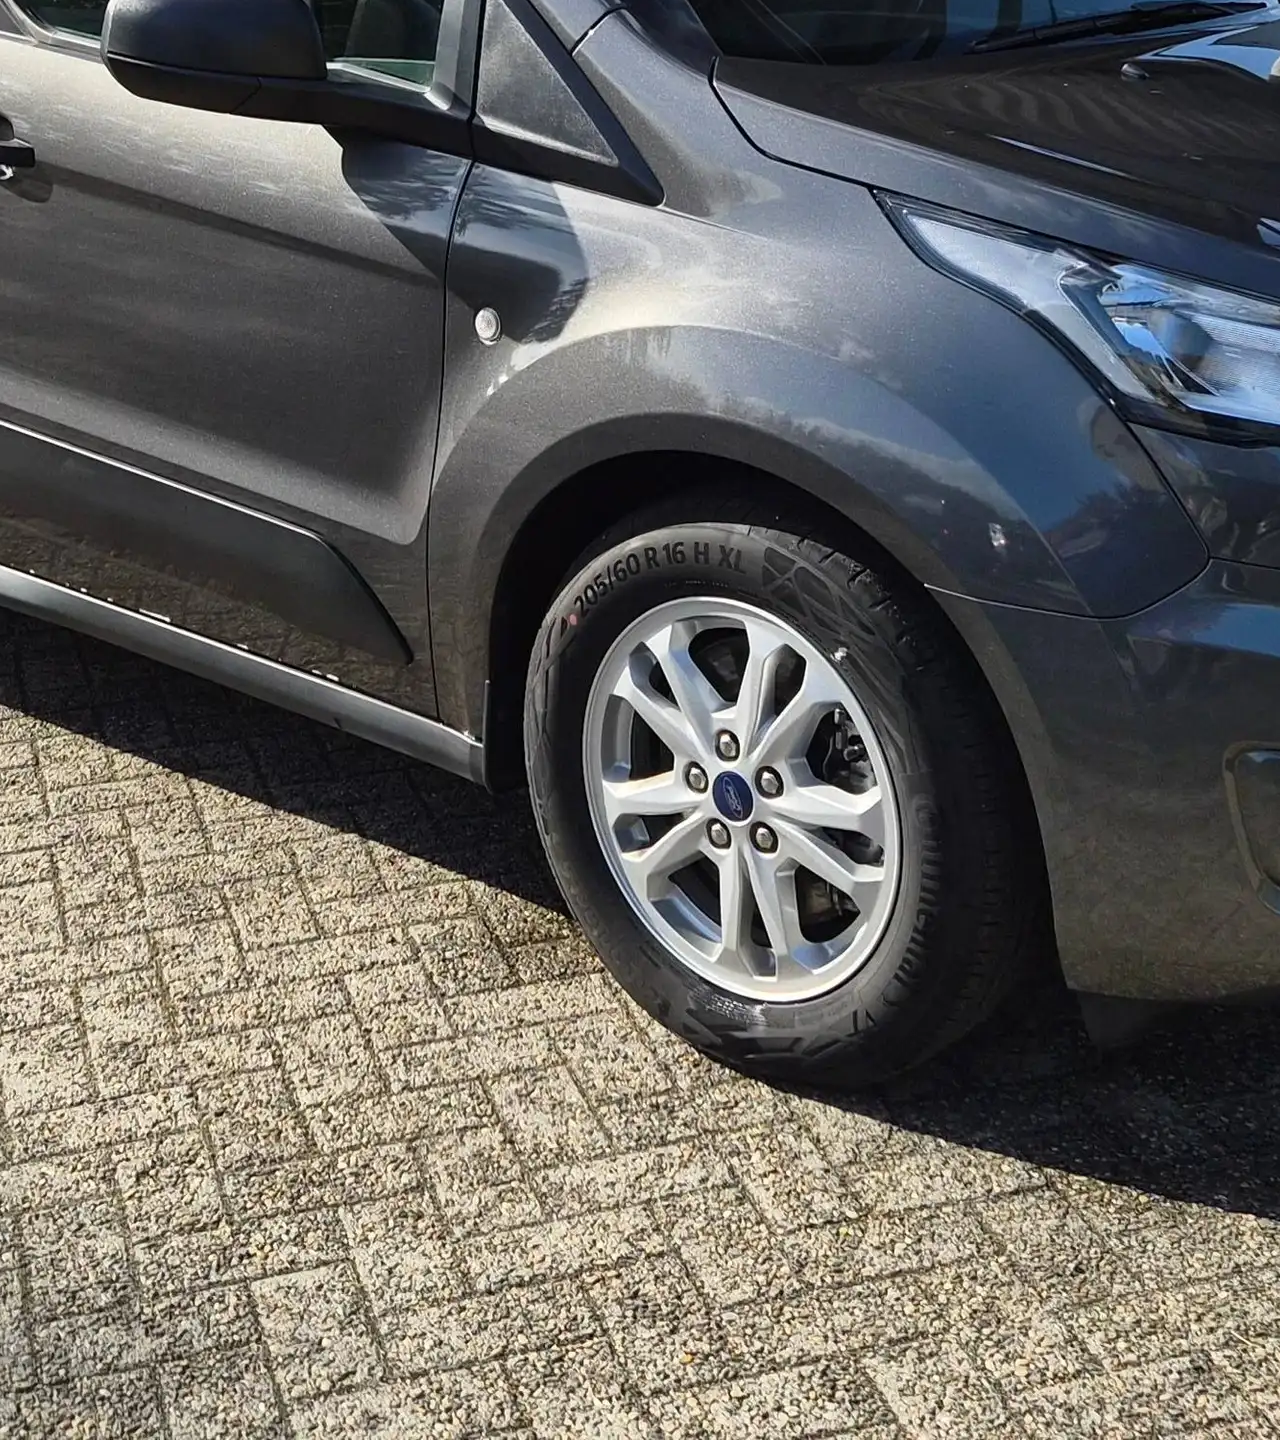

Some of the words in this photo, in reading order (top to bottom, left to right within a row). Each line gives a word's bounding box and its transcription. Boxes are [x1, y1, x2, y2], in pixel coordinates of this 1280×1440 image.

[574, 553, 641, 615] 205/60
[693, 541, 711, 565] H
[718, 544, 748, 575] XL
